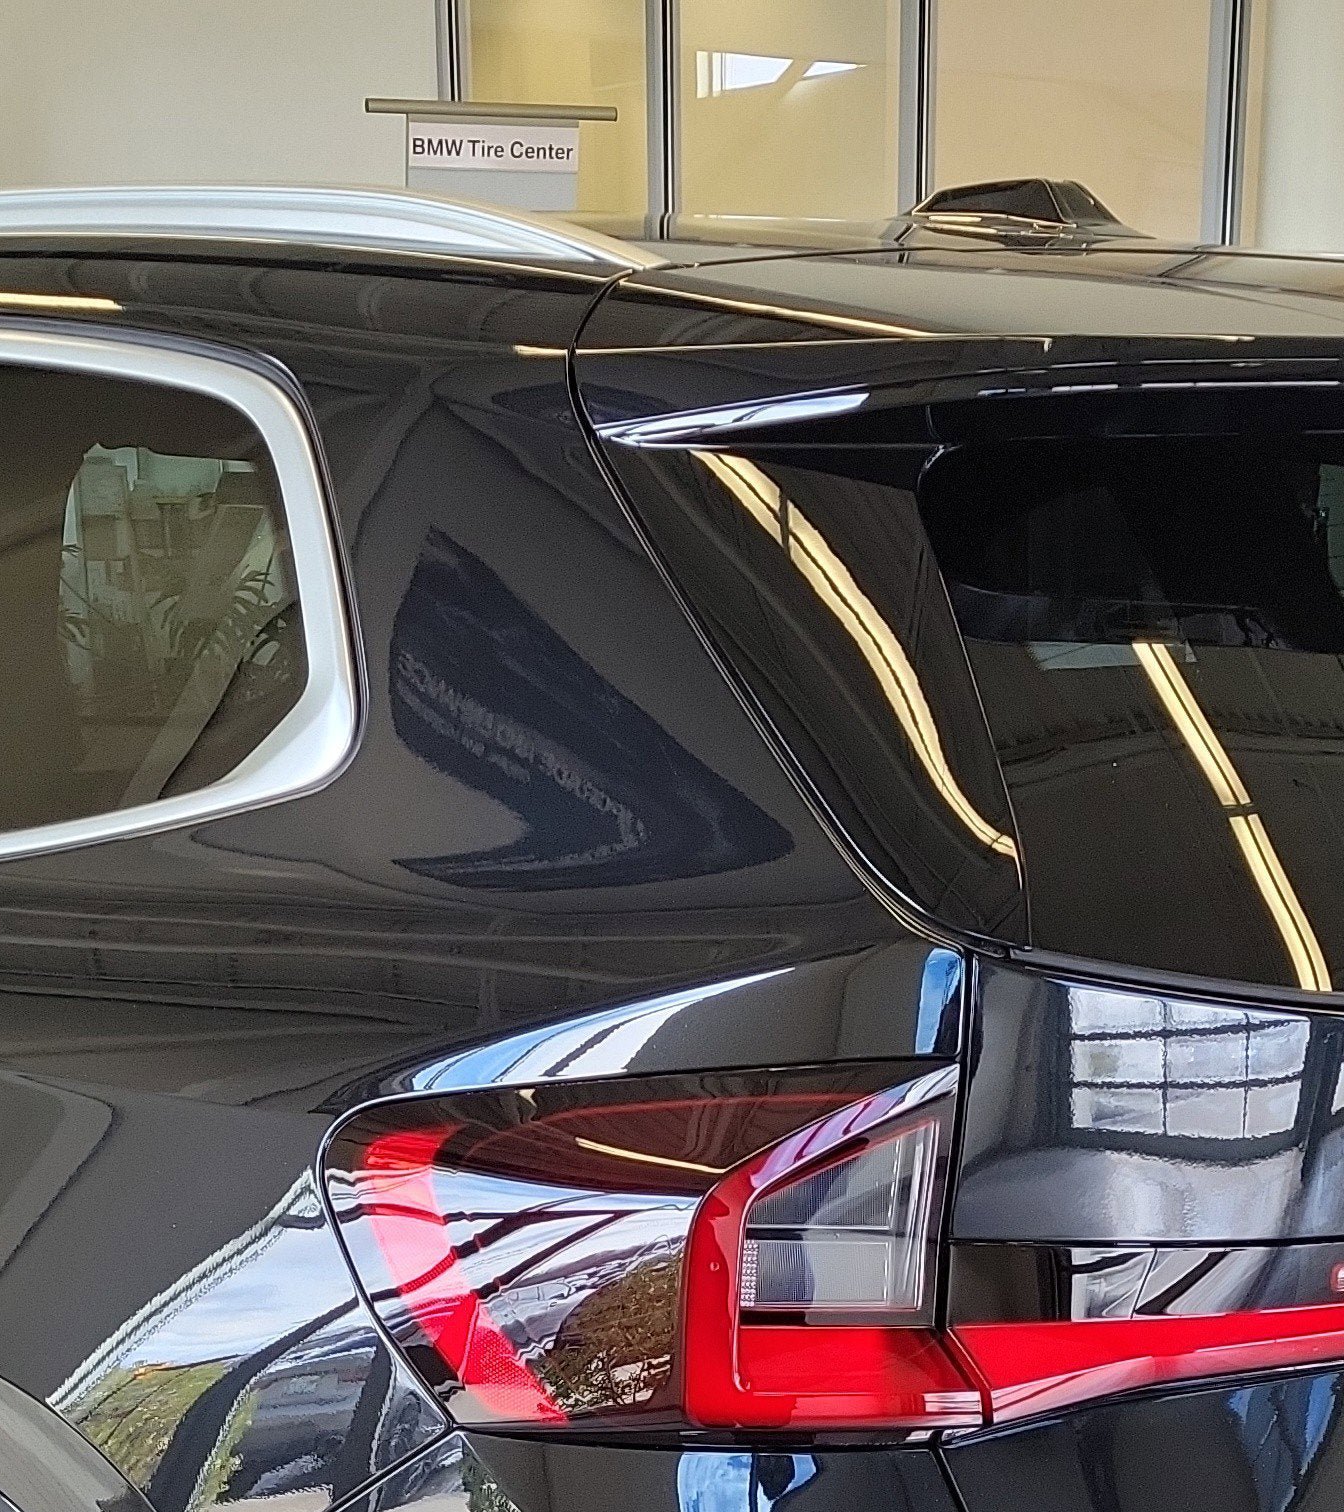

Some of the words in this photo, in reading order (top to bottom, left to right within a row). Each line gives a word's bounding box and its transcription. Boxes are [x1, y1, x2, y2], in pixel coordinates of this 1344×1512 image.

[412, 138, 463, 156] BMW
[468, 140, 504, 158] Tire
[511, 141, 573, 160] Center
